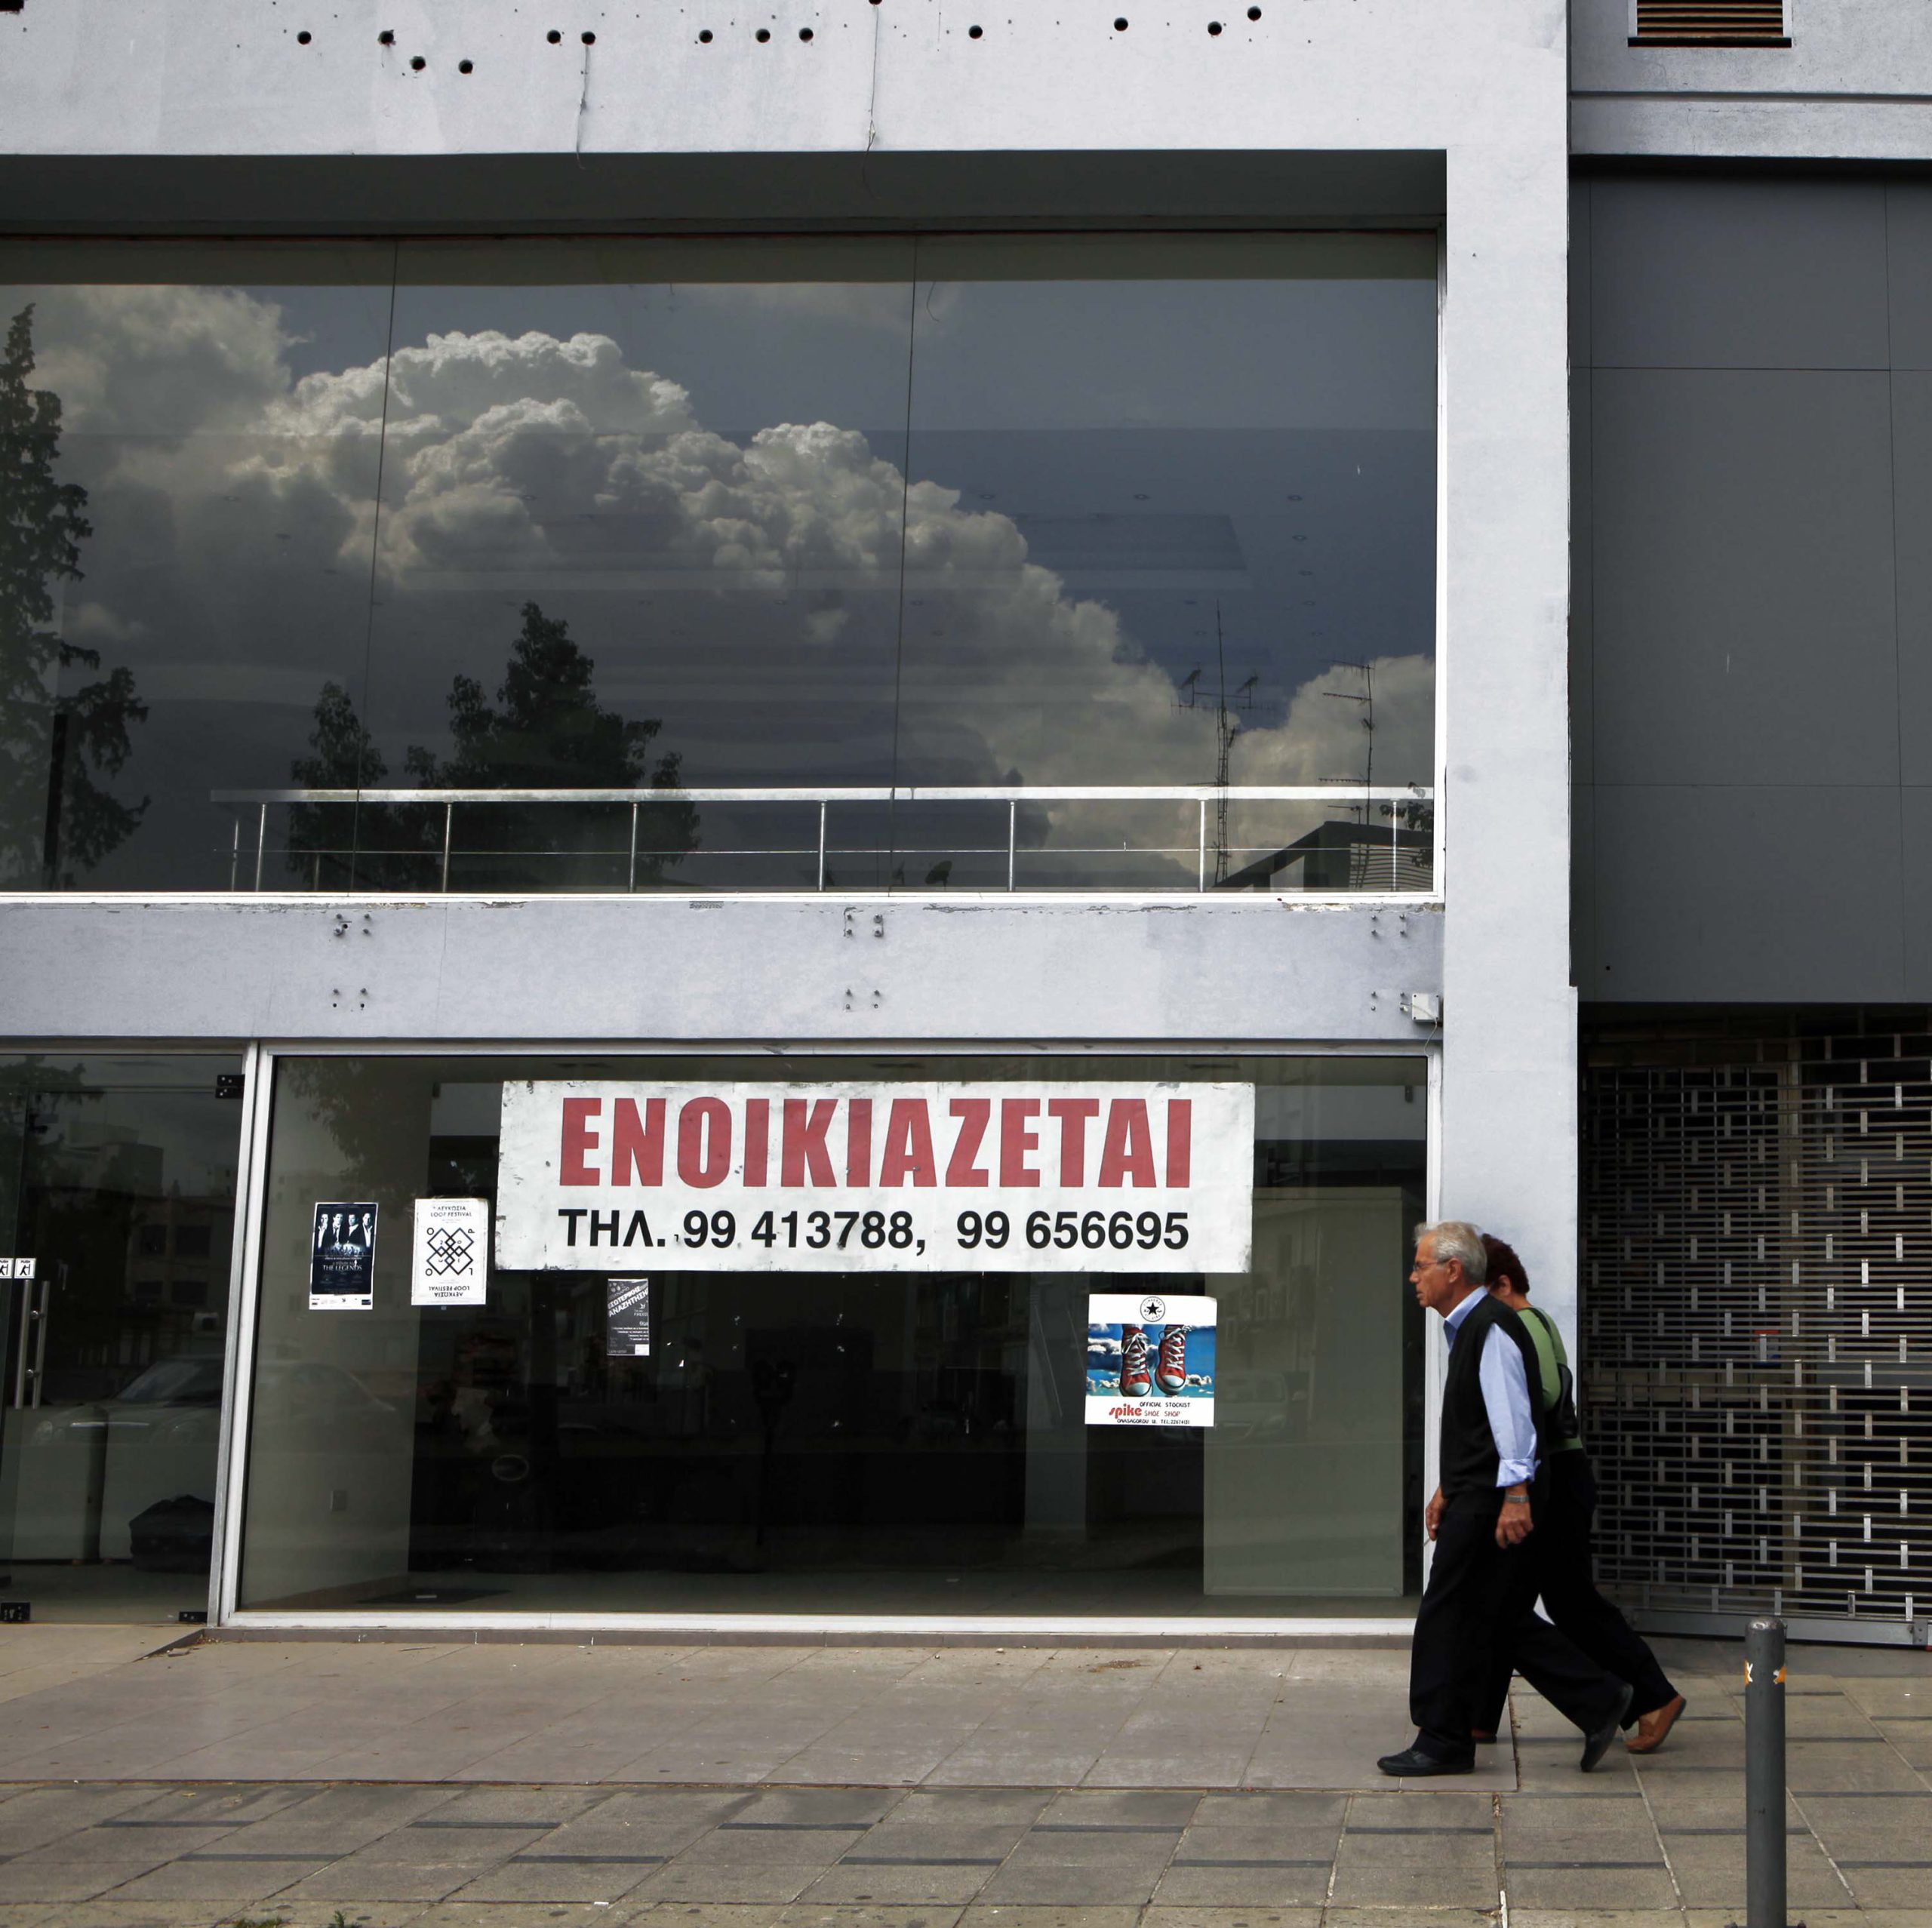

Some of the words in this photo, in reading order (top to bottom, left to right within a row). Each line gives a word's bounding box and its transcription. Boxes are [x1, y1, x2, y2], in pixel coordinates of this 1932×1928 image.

[560, 1098, 1192, 1188] ΕΝΟΙΚΙΑΖΕΤΑΙ
[558, 1209, 666, 1247] ΤΗΛ.
[683, 1210, 736, 1249] 99
[751, 1210, 925, 1256] 413788,
[957, 1210, 1010, 1249] 99
[1026, 1210, 1189, 1250] 656695
[1109, 1404, 1142, 1419] spike
